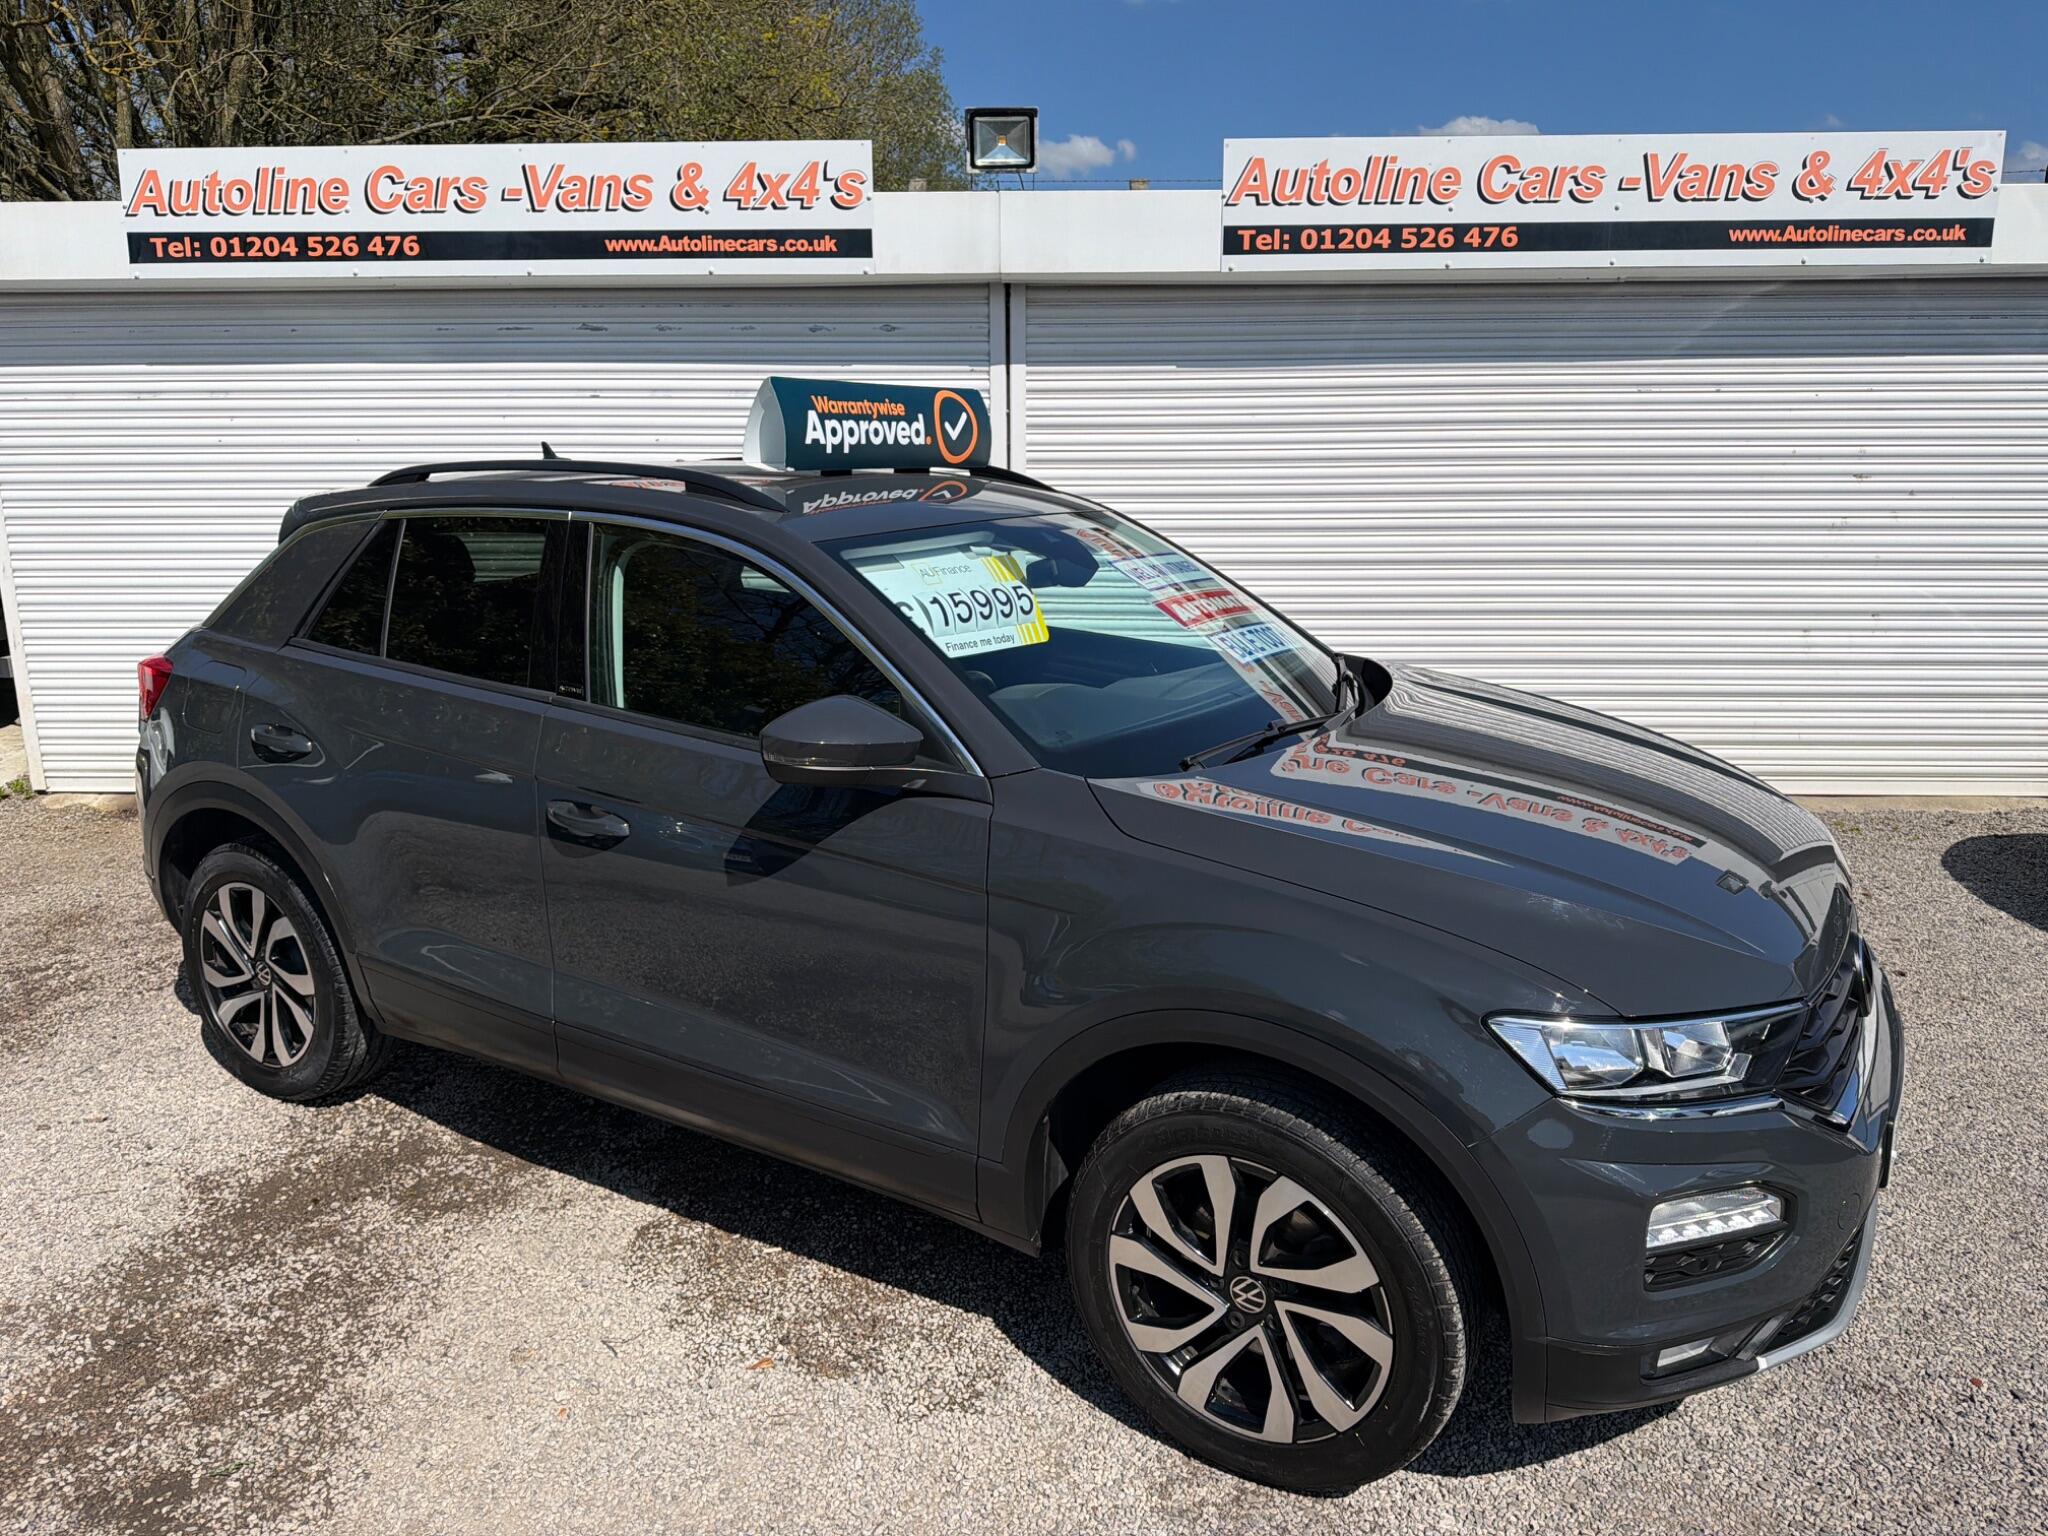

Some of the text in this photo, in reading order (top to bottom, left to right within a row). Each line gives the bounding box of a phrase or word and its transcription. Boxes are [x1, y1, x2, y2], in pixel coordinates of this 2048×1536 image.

[127, 167, 349, 215] Autoline
[367, 165, 487, 213] Cars
[673, 162, 709, 210] &
[724, 160, 867, 209] 4x4's
[1225, 156, 1461, 206] Autoline
[1478, 154, 1605, 203] Cars
[1792, 150, 1834, 199] &
[1846, 148, 1996, 197] 4x4's
[149, 235, 421, 258] Tel: 01204 526 476
[604, 236, 837, 254] www.Autolinecars.co.uk
[1238, 226, 1519, 251] Tel: 01204 526 476
[1729, 225, 1967, 244] www.Autolinecars.co.uk
[810, 395, 906, 419] Warrantywise
[804, 409, 933, 454] Approved.
[944, 633, 1016, 652] Finance me today
